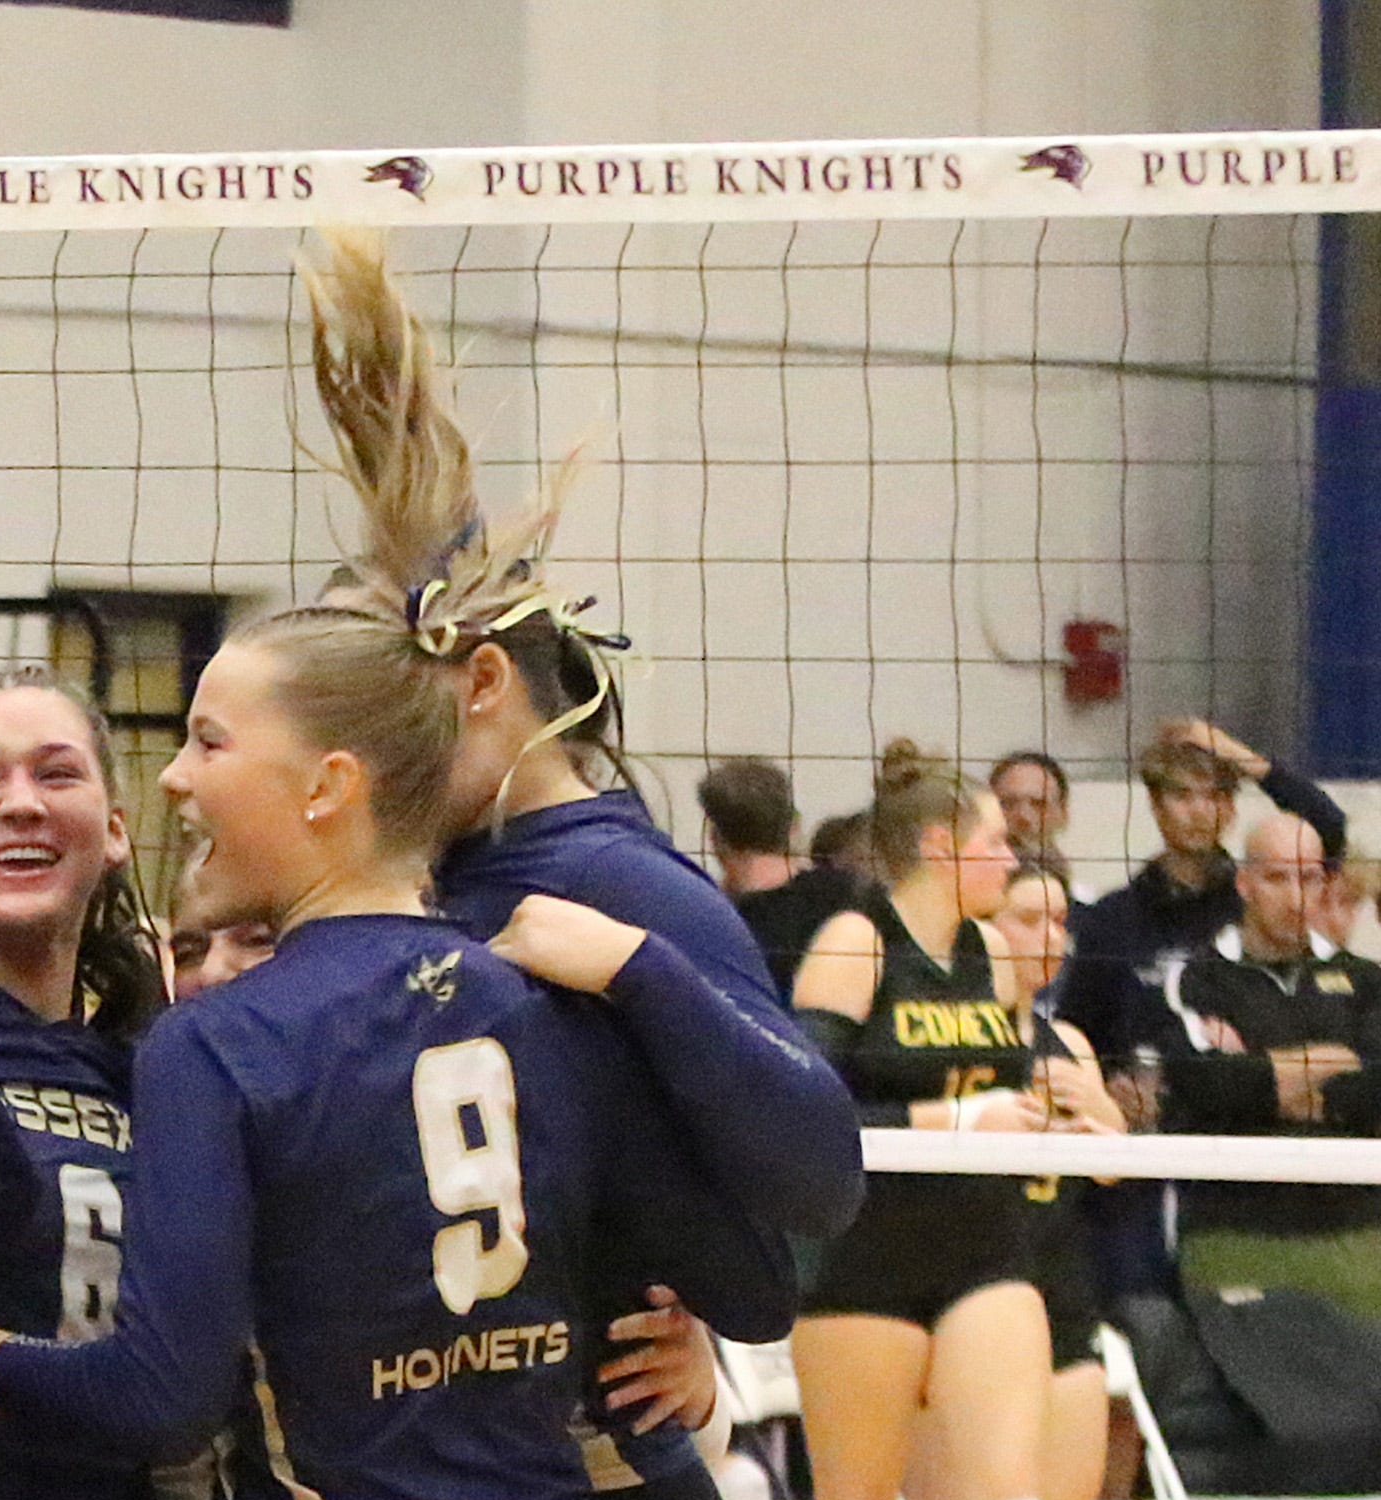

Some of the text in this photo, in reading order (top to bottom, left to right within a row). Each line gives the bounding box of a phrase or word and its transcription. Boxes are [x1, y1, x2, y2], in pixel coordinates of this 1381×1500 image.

[77, 163, 315, 204] KNIGHTS
[482, 152, 964, 197] PURPLE KNIGHTS
[1143, 146, 1358, 187] PURPLE
[411, 1036, 529, 1316] 9
[57, 1162, 125, 1341] 6
